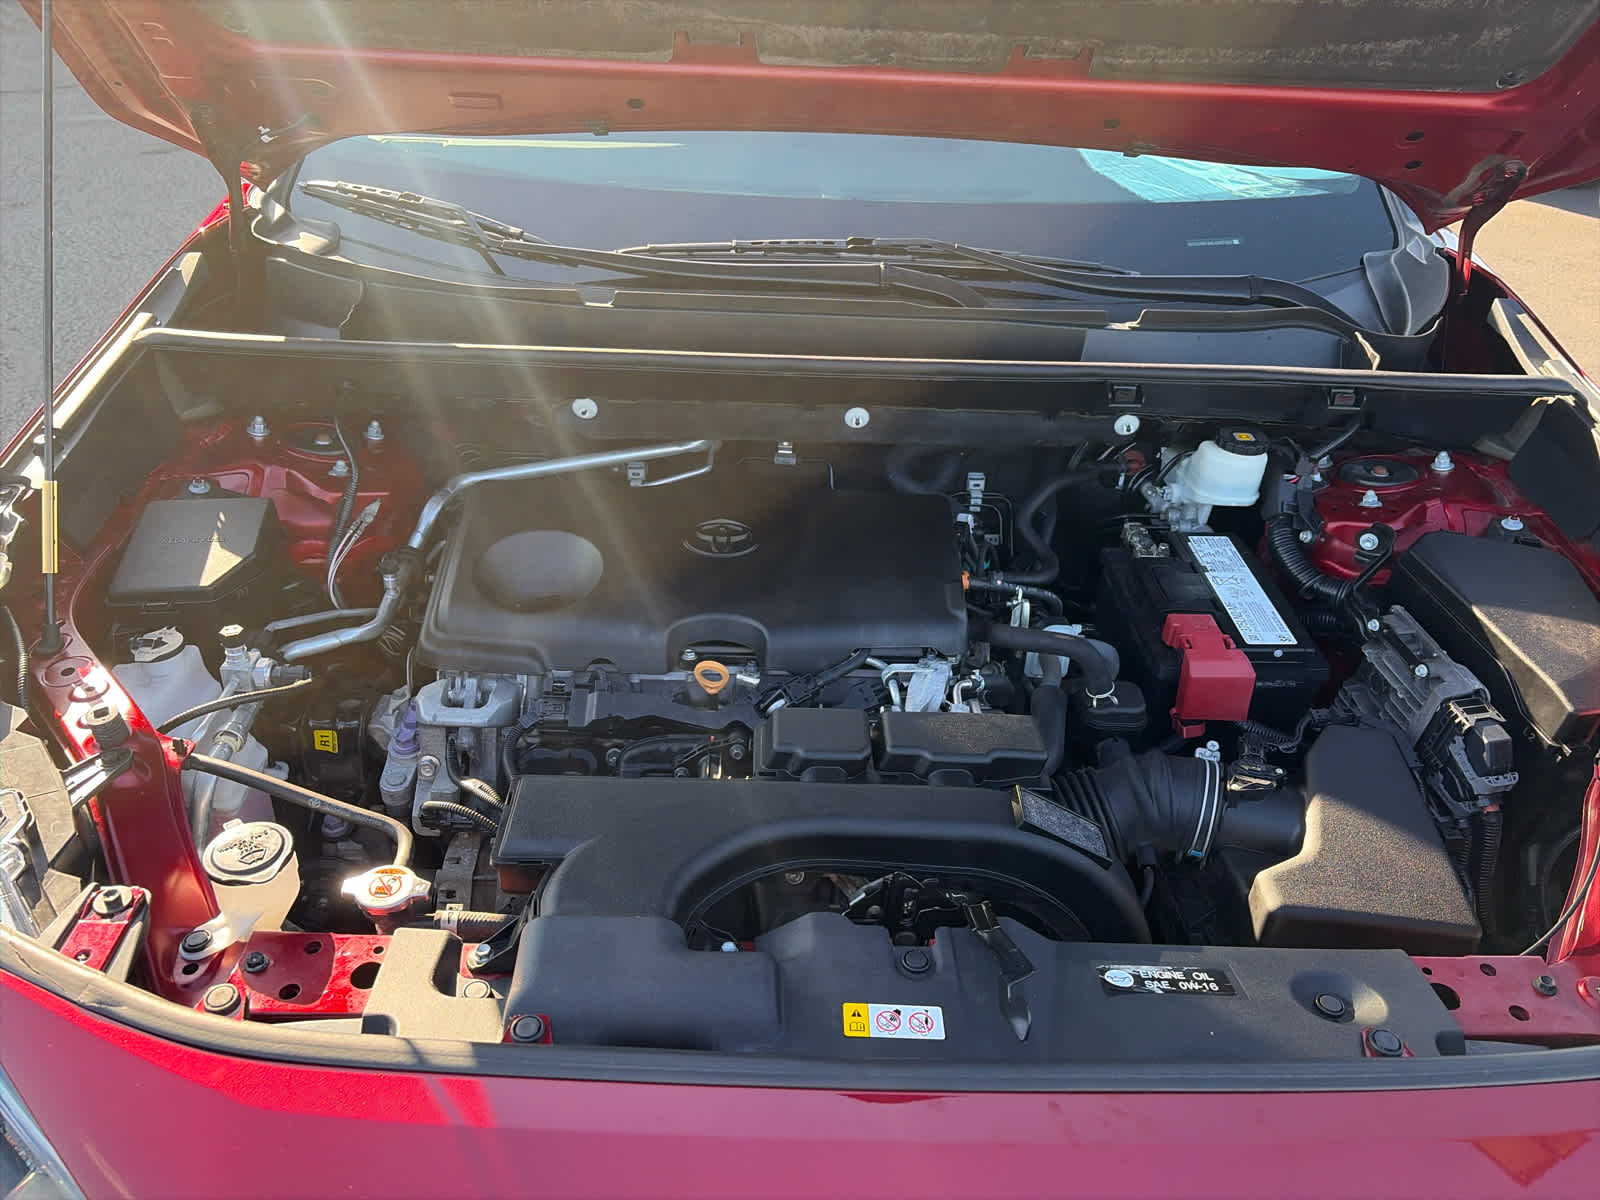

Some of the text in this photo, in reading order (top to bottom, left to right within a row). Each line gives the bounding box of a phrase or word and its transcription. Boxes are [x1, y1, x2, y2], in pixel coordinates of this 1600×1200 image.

[319, 735, 330, 747] R1
[1139, 970, 1215, 982] ENGINE OIL
[1144, 980, 1219, 992] SAE 0W-16
